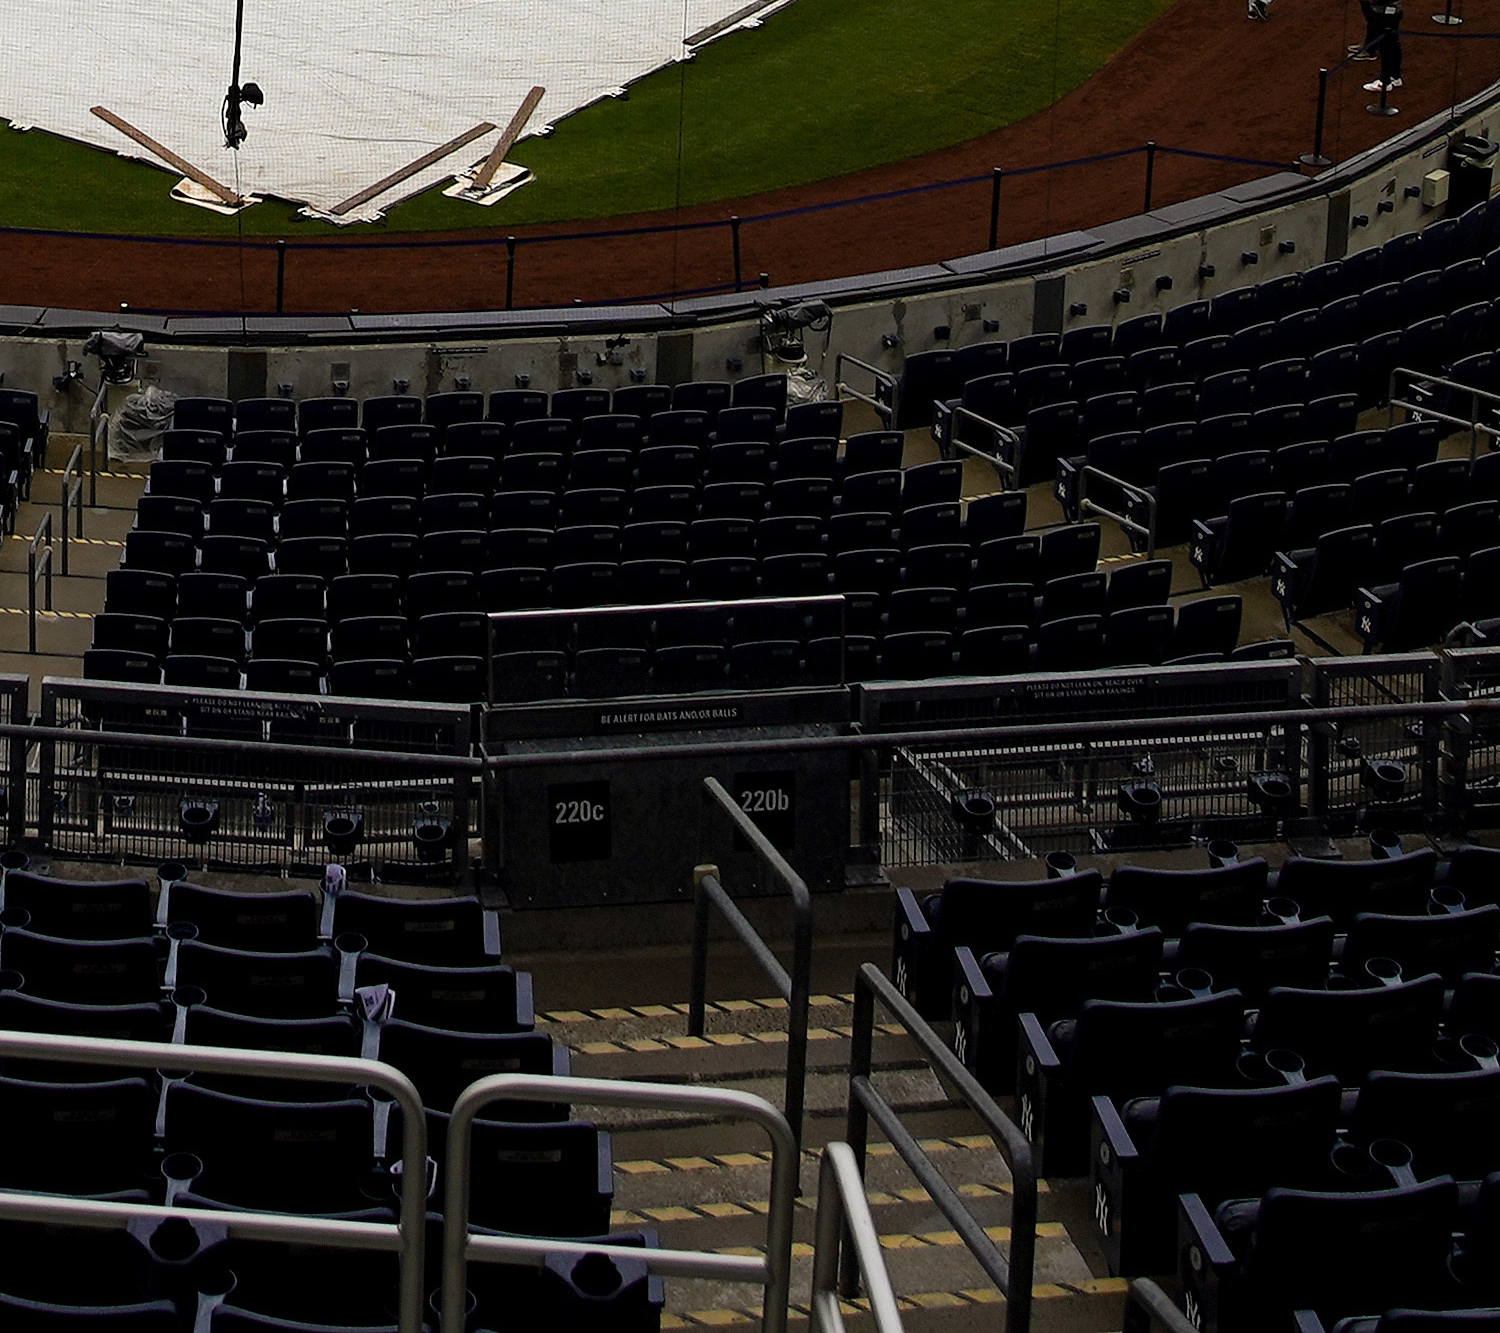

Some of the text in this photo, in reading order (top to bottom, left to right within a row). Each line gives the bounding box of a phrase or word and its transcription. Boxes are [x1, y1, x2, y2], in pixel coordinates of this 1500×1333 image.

[613, 713, 637, 724] ALERT
[640, 712, 655, 722] FOR
[657, 711, 677, 721] BATS
[712, 707, 738, 718] BALLS
[555, 800, 605, 824] 220c
[741, 789, 789, 812] 220b
